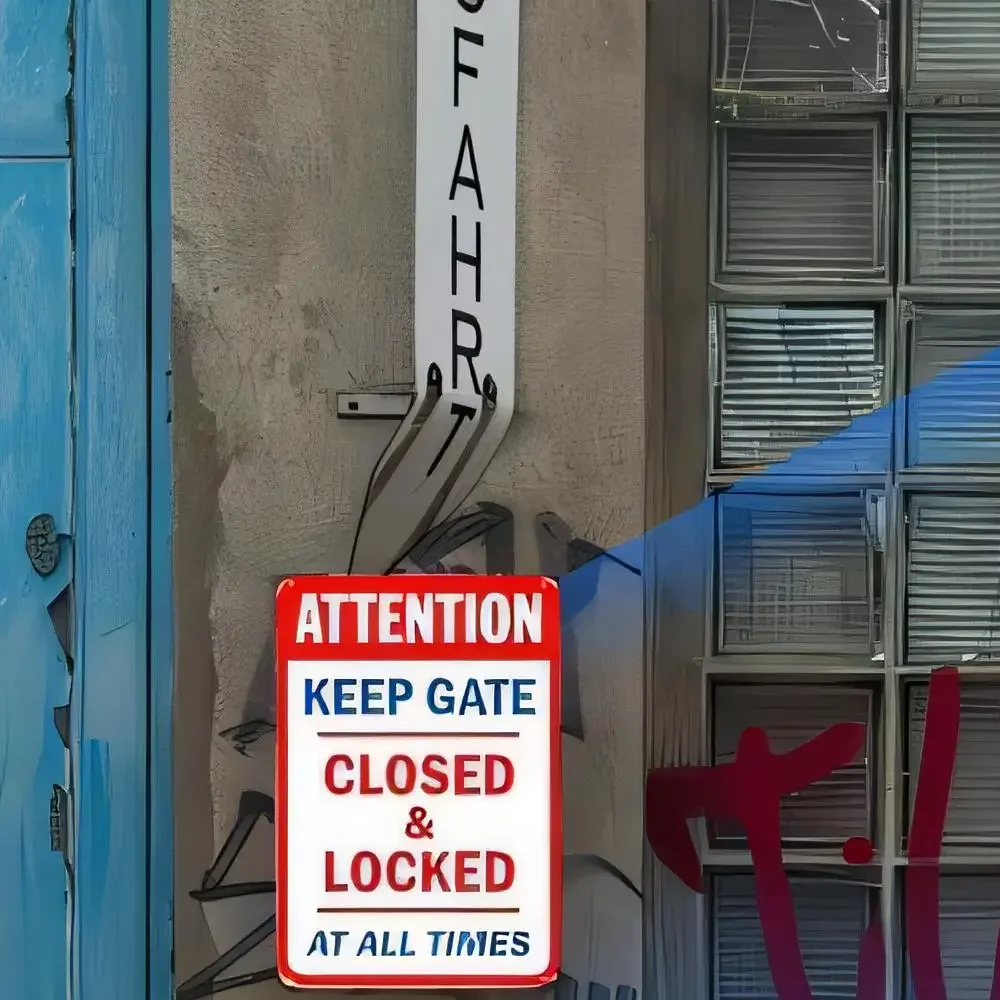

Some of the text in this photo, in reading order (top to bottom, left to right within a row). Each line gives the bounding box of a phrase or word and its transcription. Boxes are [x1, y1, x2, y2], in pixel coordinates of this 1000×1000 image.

[424, 0, 485, 479] FAHRT
[295, 592, 542, 644] ATTENTION
[304, 677, 536, 716] KEEP GATE
[324, 753, 515, 796] CLOSED
[404, 806, 434, 840] &
[324, 850, 515, 893] LOCKED
[306, 930, 530, 957] AT ALL TIMES
